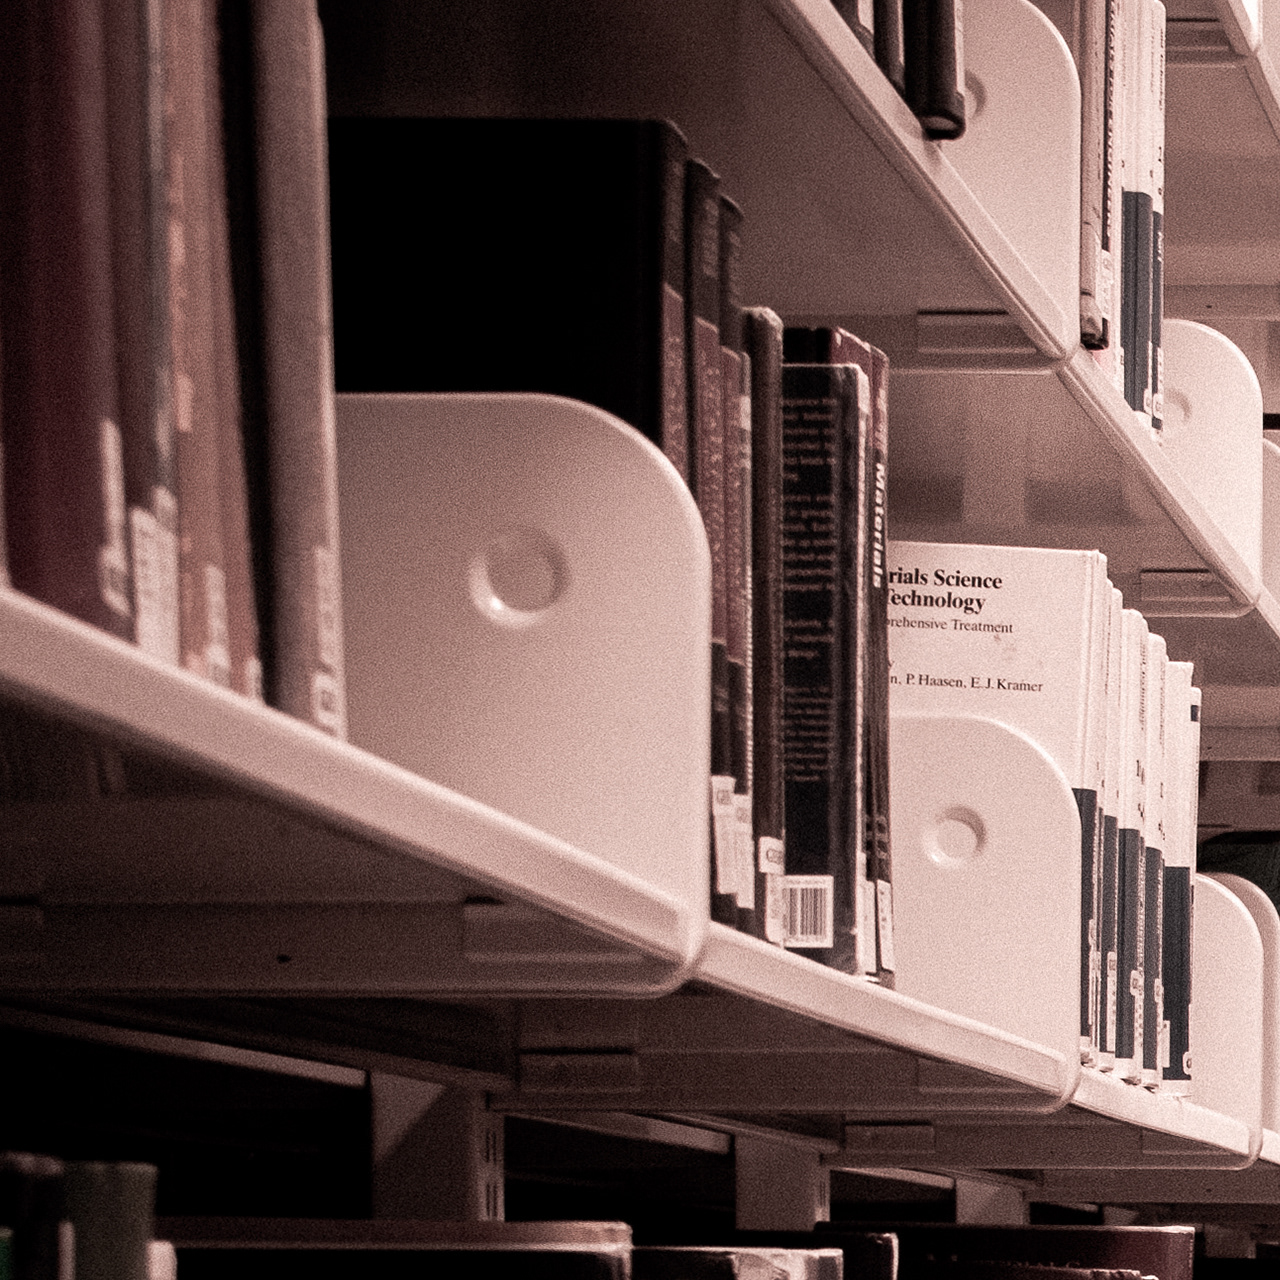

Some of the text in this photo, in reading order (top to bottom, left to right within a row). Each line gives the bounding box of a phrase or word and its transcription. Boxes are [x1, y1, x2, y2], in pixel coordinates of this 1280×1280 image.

[872, 461, 887, 589] Materials
[888, 567, 1003, 590] rials Science
[951, 618, 1014, 634] Treatment
[996, 678, 1044, 692] Kramer
